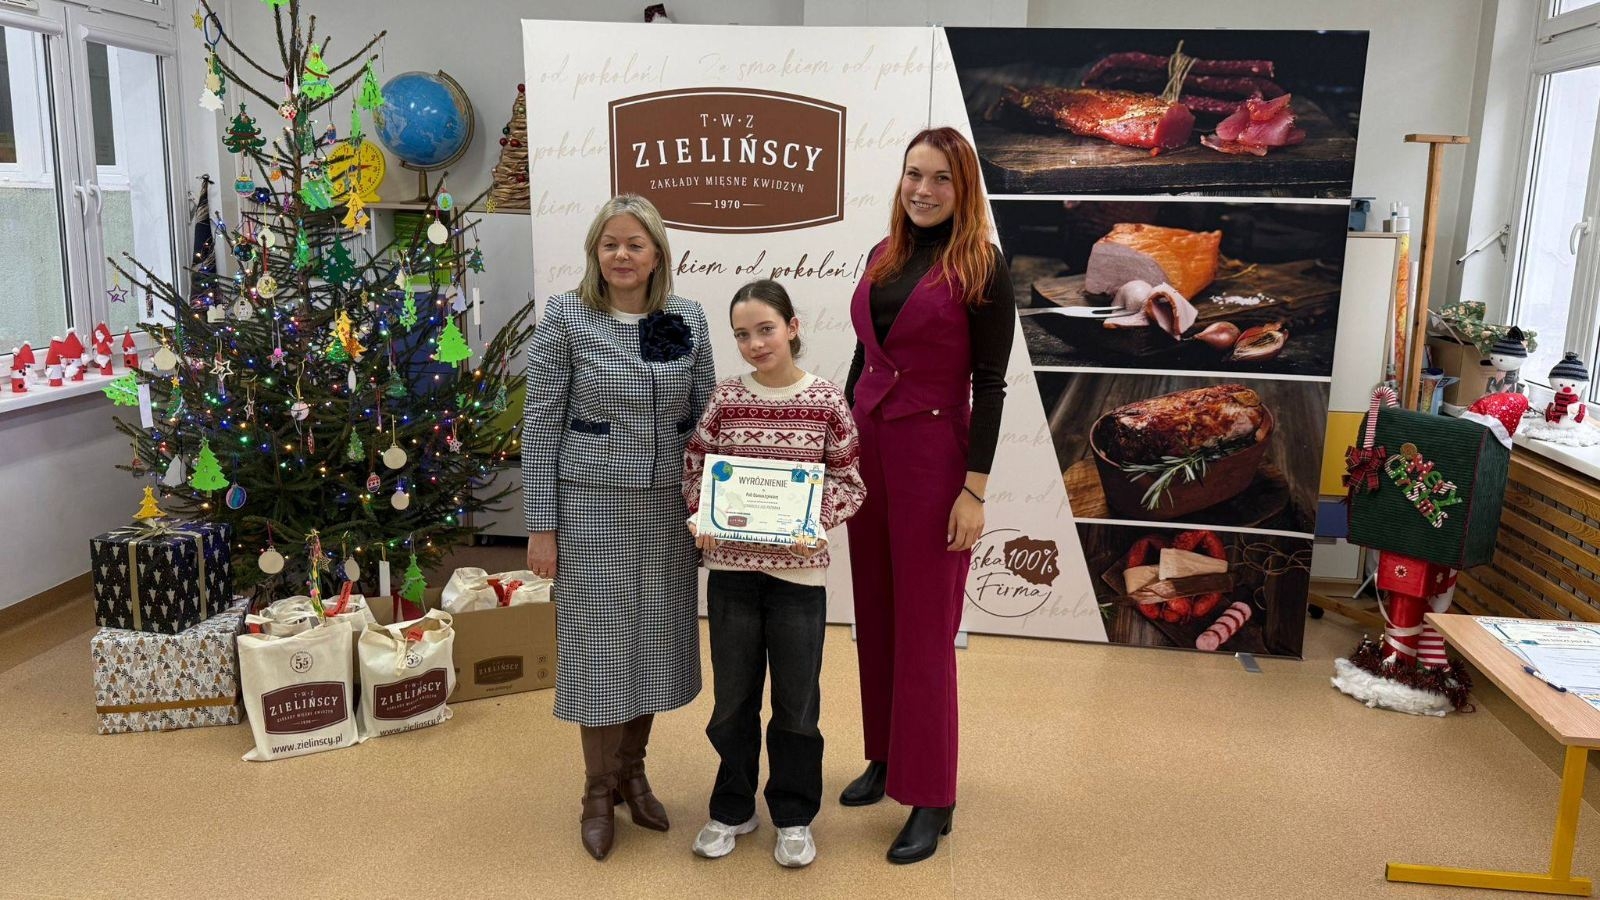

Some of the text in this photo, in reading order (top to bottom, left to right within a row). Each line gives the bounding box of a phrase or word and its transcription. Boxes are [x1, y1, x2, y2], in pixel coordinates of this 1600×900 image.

[632, 133, 823, 172] ZIELIŃSCY
[650, 176, 805, 193] ZAKŁADY MIĘSNE KWIDZYN
[714, 199, 741, 209] 1970
[673, 250, 864, 284] kiem od pokoleń!
[1008, 548, 1057, 575] 100%
[976, 571, 1048, 601] Firma
[269, 695, 339, 717] ZIELIŃSCY
[271, 732, 343, 754] www.zielinscy.pl
